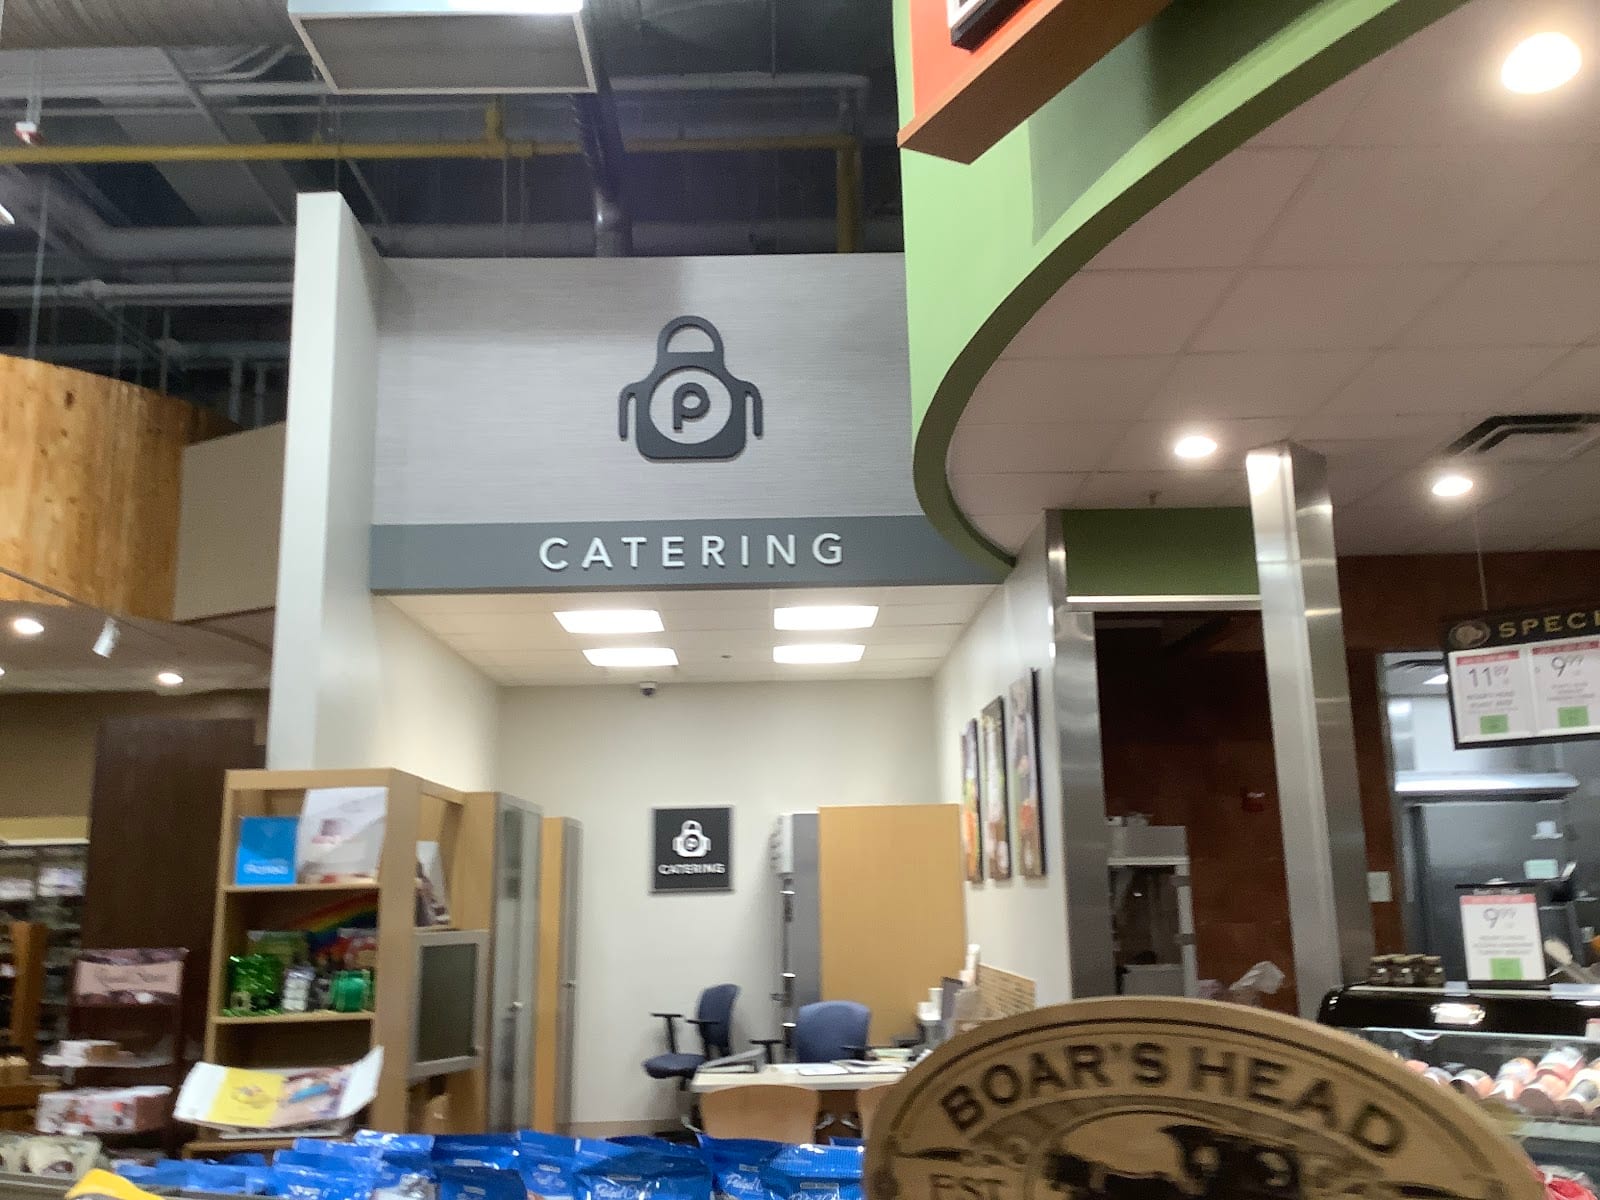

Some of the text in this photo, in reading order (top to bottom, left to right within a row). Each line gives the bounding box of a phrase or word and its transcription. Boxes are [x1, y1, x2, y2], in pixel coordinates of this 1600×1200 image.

[538, 532, 843, 570] CATERING
[657, 862, 726, 875] CATERING
[940, 1041, 1408, 1155] BOAR'S HEAD
